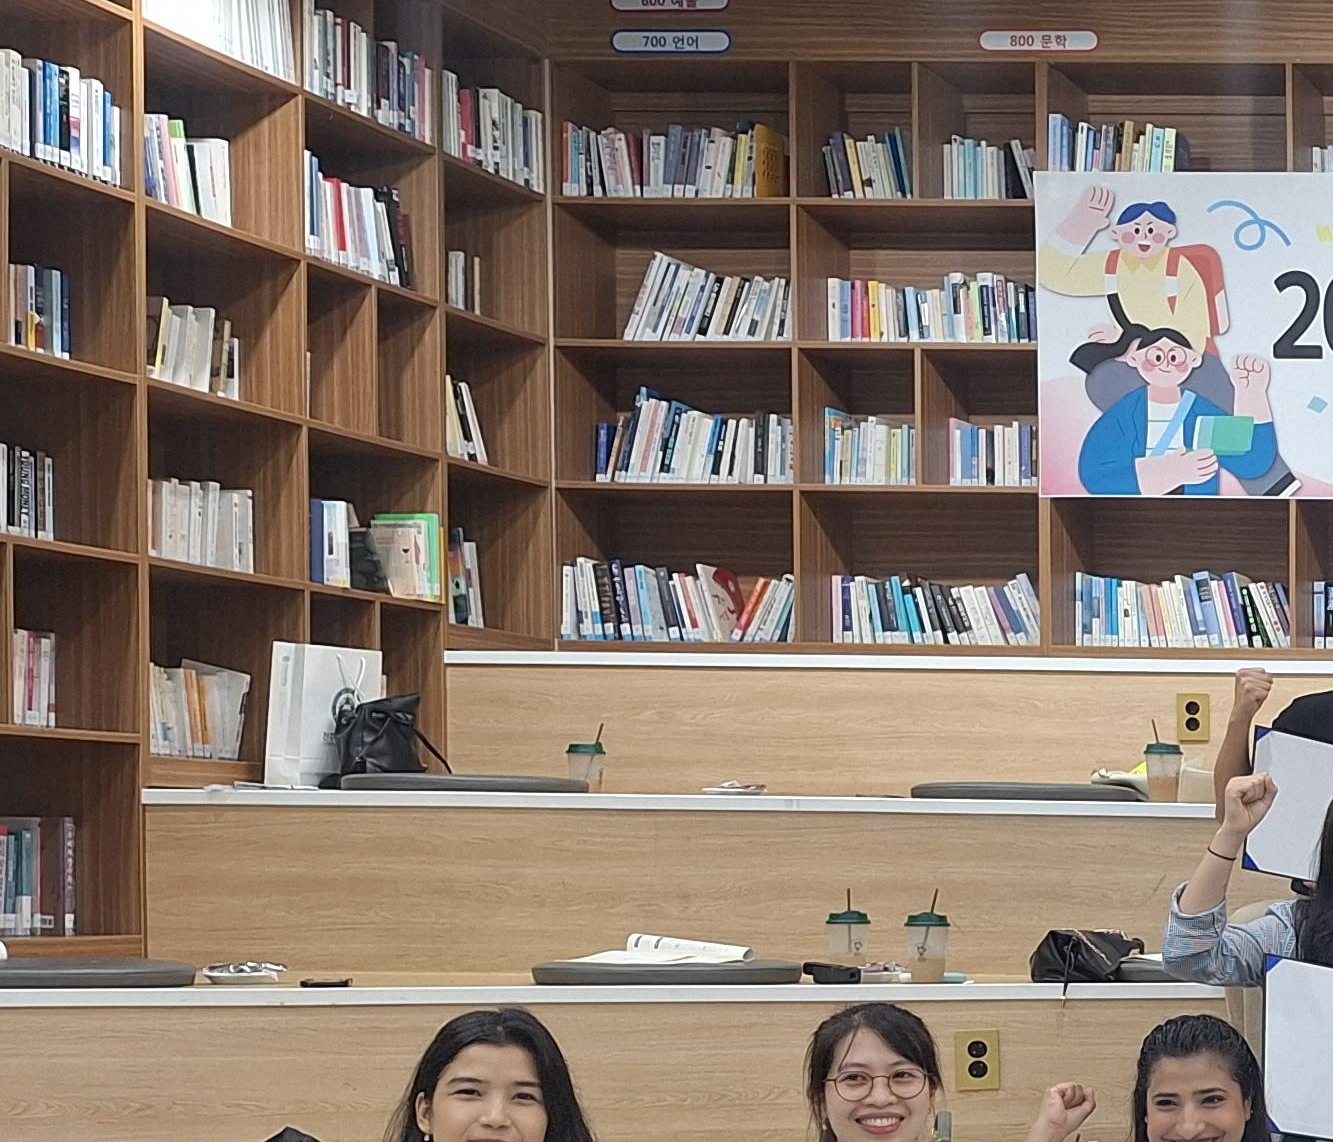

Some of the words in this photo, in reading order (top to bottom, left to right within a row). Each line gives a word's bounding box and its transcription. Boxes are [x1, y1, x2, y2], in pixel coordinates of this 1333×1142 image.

[642, 36, 666, 48] 700
[672, 36, 699, 49] 언어
[1010, 35, 1034, 47] 800
[1042, 34, 1067, 49] 문학
